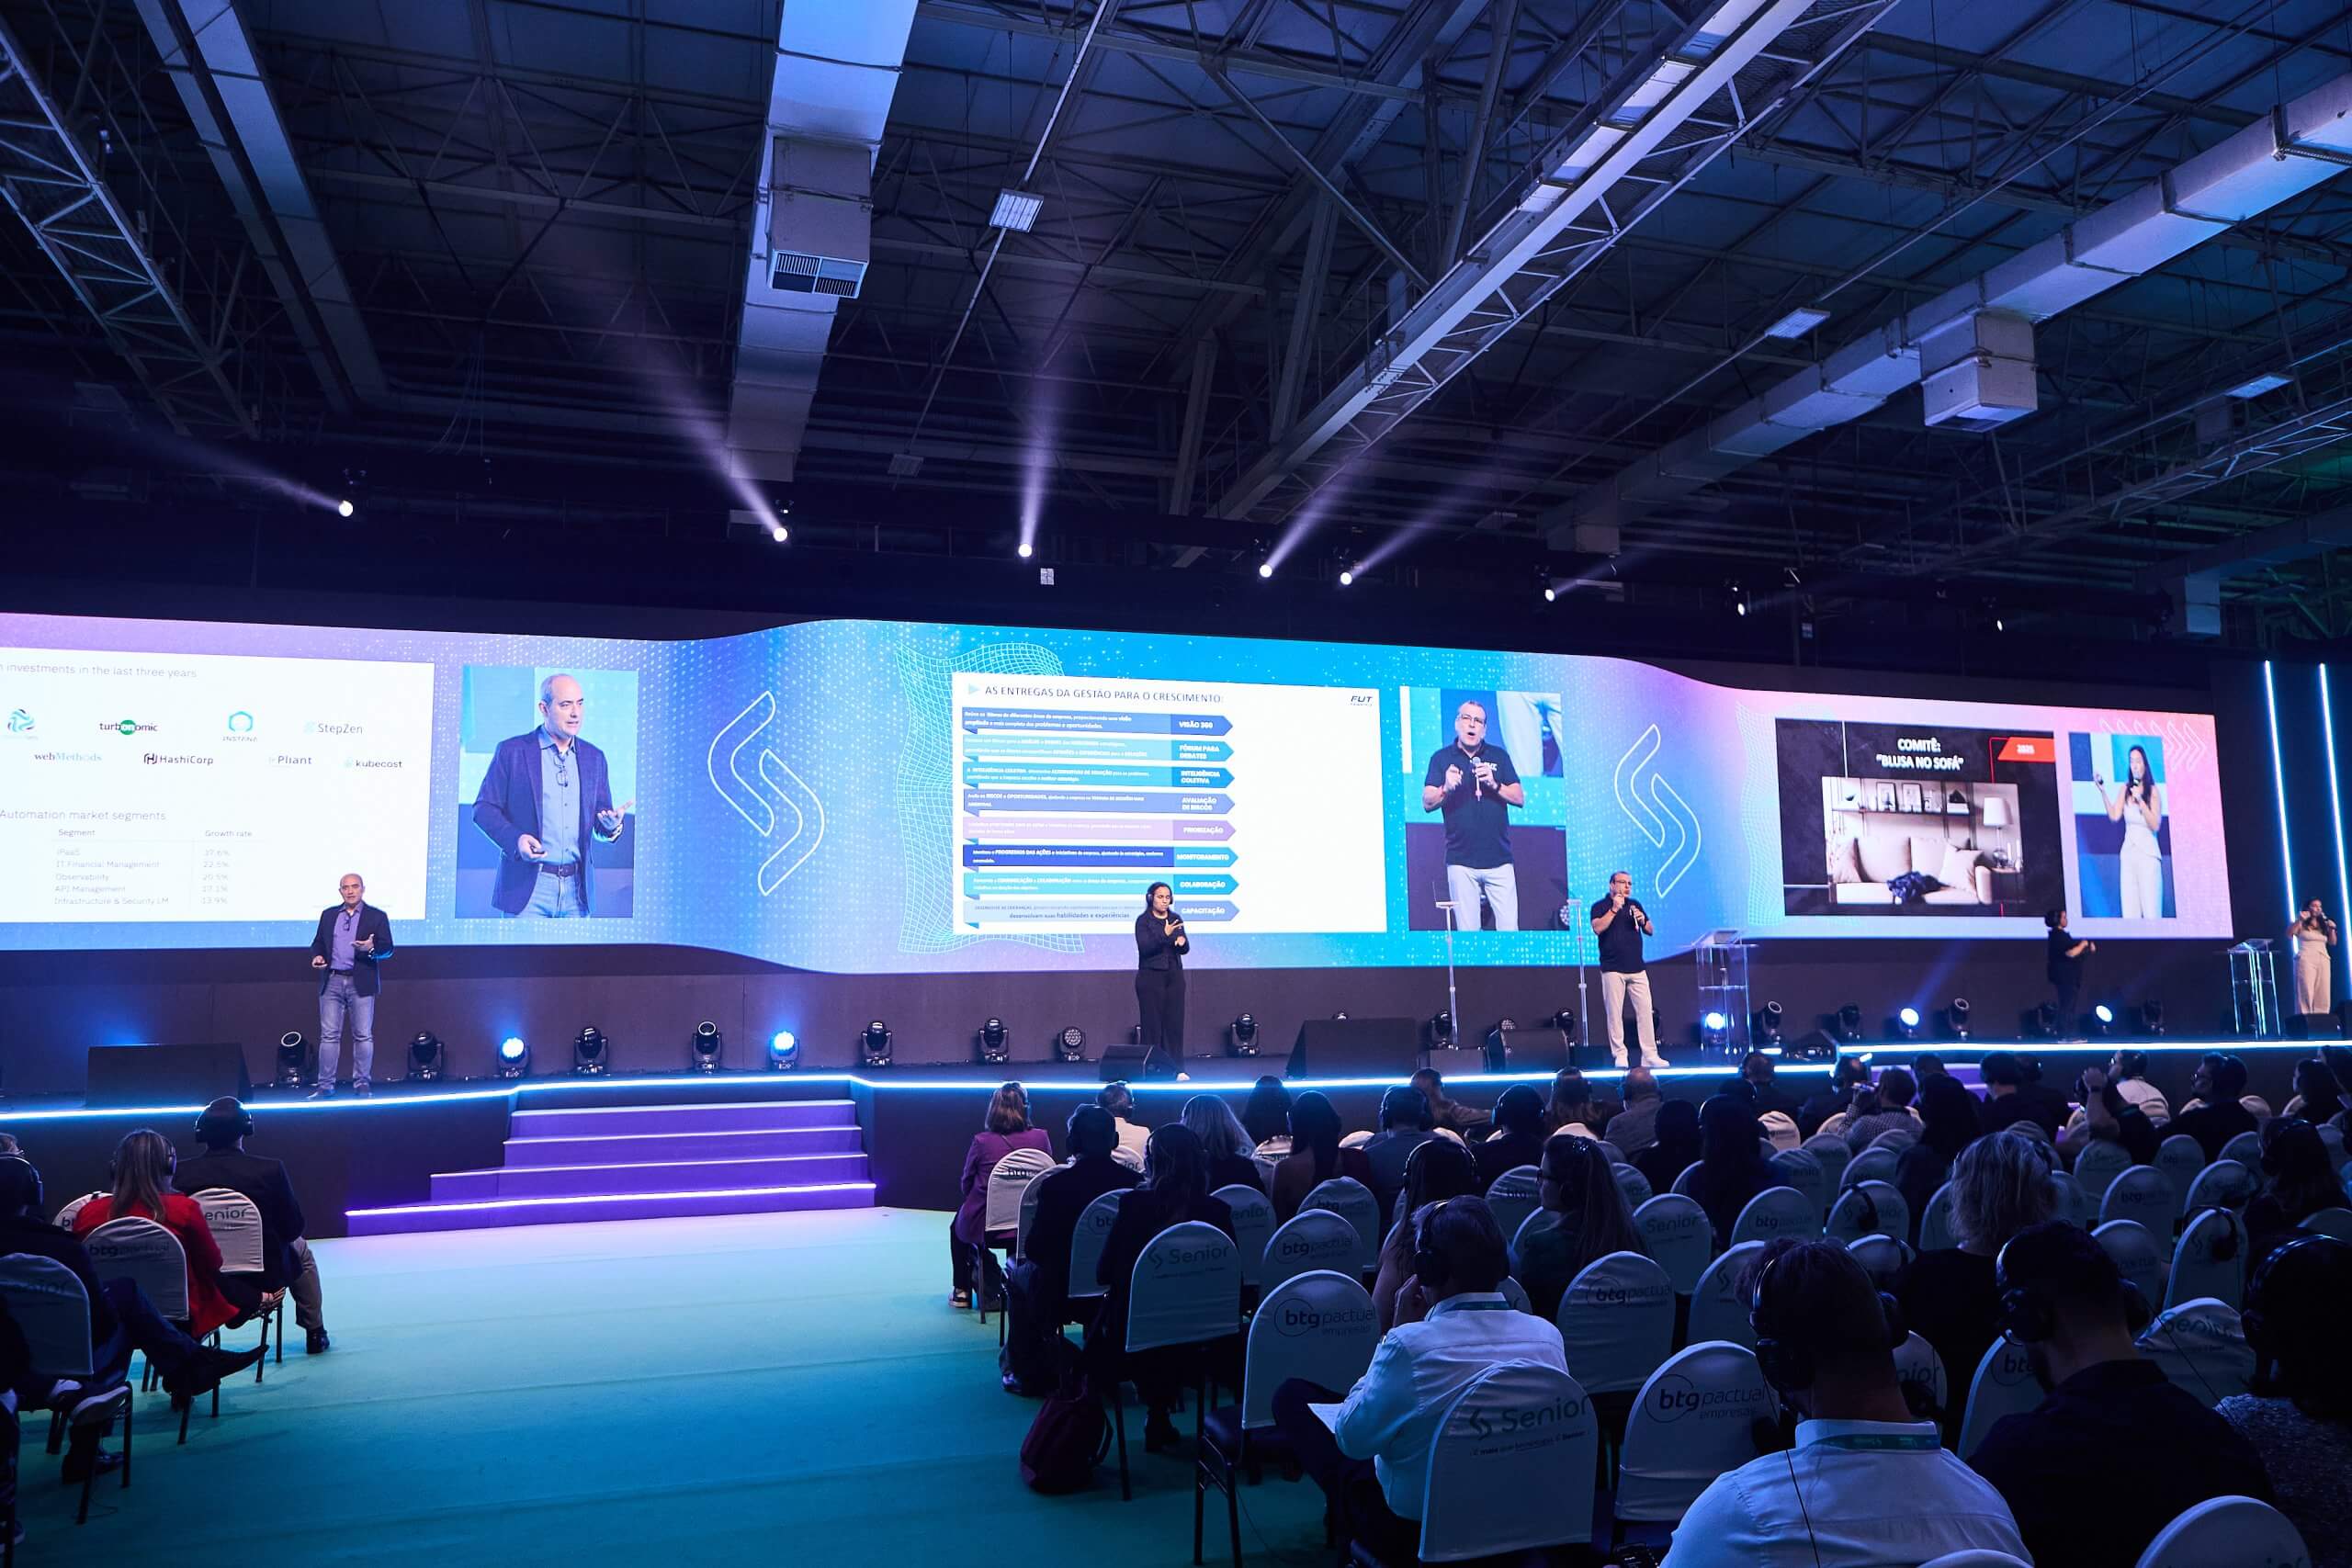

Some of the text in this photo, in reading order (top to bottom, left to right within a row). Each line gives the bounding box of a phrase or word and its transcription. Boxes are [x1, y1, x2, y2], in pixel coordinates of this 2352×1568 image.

[7, 662, 75, 674] investments
[79, 664, 89, 674] in
[92, 665, 110, 676] the
[113, 666, 133, 676] last
[136, 667, 165, 677] three
[167, 669, 198, 681] years
[985, 685, 999, 695] AS
[1001, 686, 1055, 697] ENTREGAS
[1057, 688, 1071, 698] DA
[1073, 687, 1113, 699] GESTÃO
[1114, 690, 1140, 700] PARA
[1142, 691, 1150, 701] O
[98, 721, 159, 733] turbonomic
[318, 723, 364, 735] StepZen
[1179, 720, 1200, 728] VISÃO
[1179, 743, 1220, 753] FÓRUM PARA
[1897, 737, 1941, 752] COMITÊ:
[160, 755, 214, 767] HashiCorp
[277, 755, 313, 765] Pliant
[356, 759, 403, 769] kubecost
[1916, 756, 1933, 770] NO
[0, 809, 166, 823] Automation market segments
[59, 829, 96, 839] Segment
[205, 829, 235, 838] Growth
[107, 860, 162, 871] Management
[55, 874, 109, 883] Observability
[54, 897, 112, 905] Infrastructure
[205, 1207, 247, 1221] enior
[1232, 1201, 1269, 1220] enior
[1646, 1213, 1698, 1234] Senior
[1169, 1245, 1229, 1265] Senior
[1896, 1360, 1939, 1383] nior
[1502, 1394, 1589, 1432] Senior
